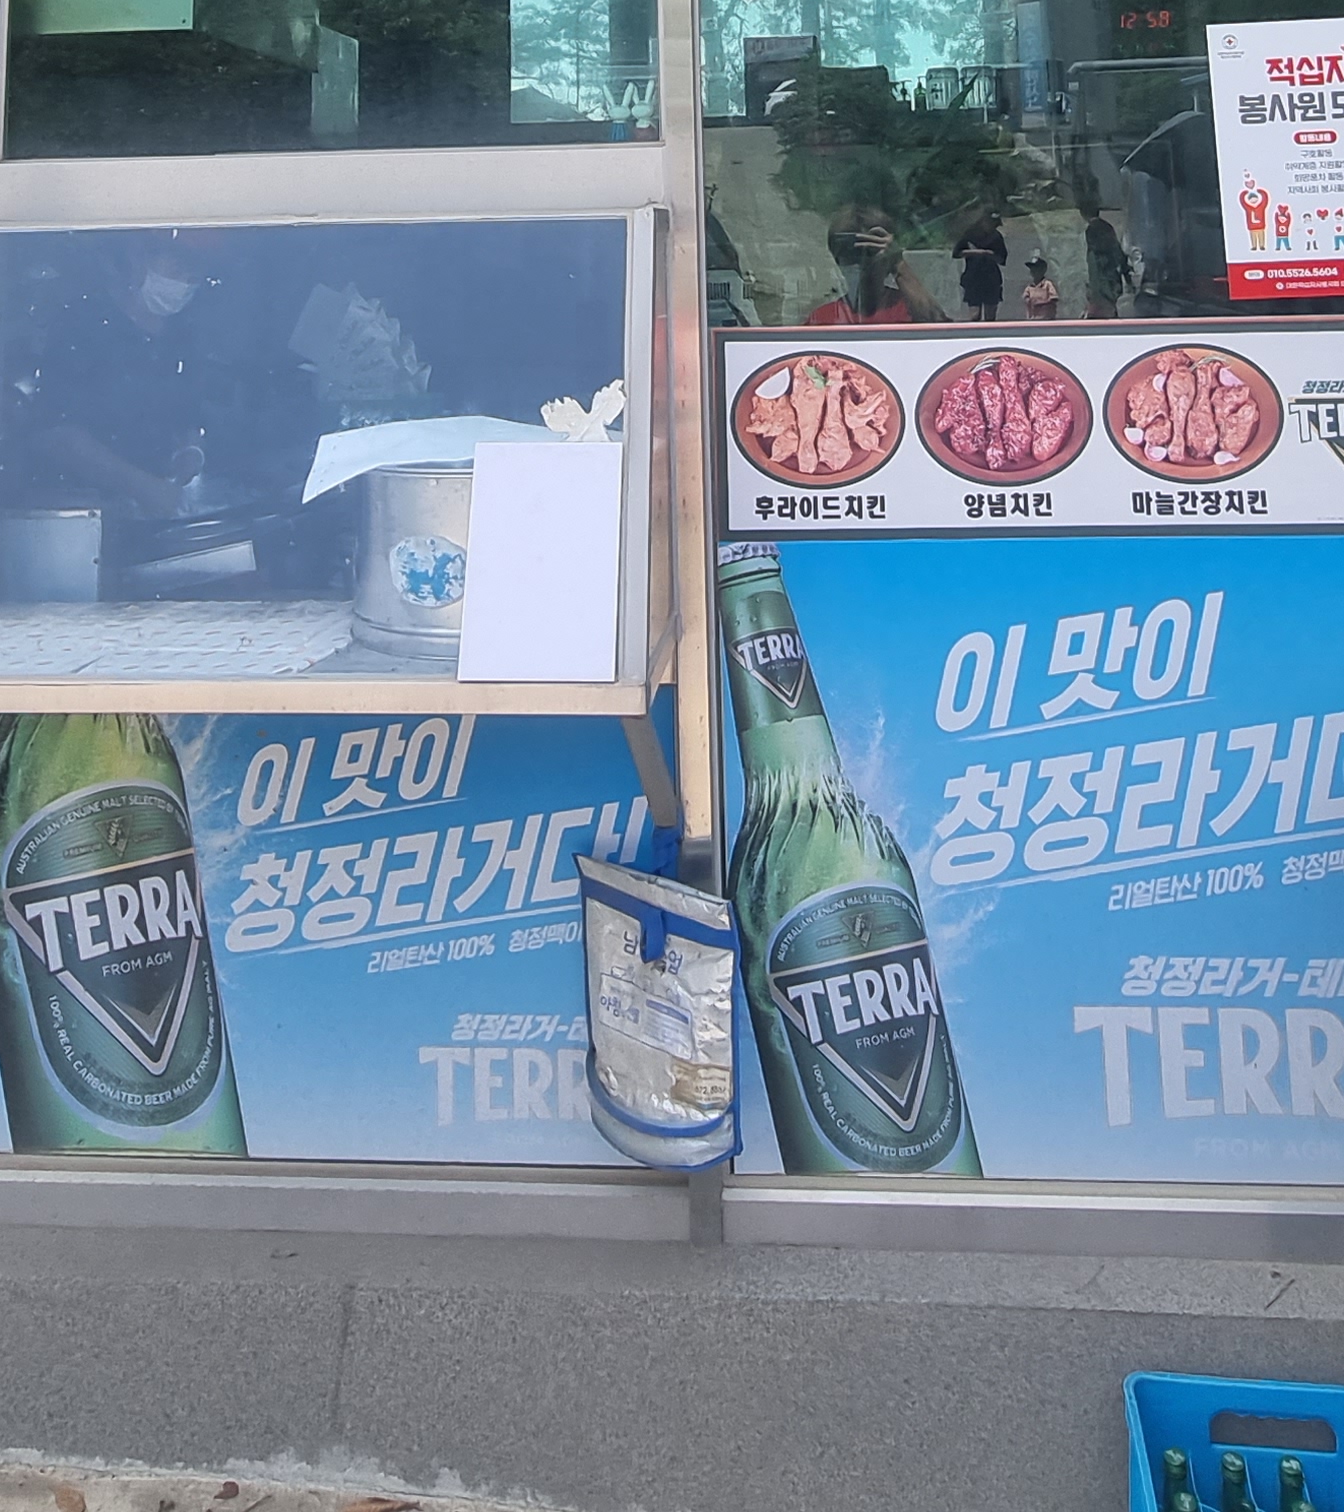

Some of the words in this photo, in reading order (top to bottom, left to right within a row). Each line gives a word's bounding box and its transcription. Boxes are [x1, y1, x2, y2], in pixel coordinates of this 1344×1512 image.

[1238, 91, 1327, 125] 봉사원
[754, 492, 887, 522] 후라이드치킨
[963, 490, 1054, 519] 양념치킨
[1131, 488, 1269, 517] 마늘간장치킨
[934, 624, 1027, 733] 이
[1040, 591, 1224, 721] 맛이
[237, 737, 316, 826] 이
[322, 714, 476, 817] 맛이
[15, 822, 61, 875] AUSTRALIAN
[60, 800, 102, 826] GENUINE
[1108, 872, 1202, 911] 리얼탄산
[1206, 862, 1264, 897] 100%
[25, 869, 203, 973] TERRA
[102, 957, 143, 977] FROM
[146, 951, 174, 968] AGM
[367, 941, 445, 974] 리얼탄산
[447, 933, 497, 962] 100%
[787, 957, 939, 1045] TERRA
[855, 1032, 890, 1049] FROM
[892, 1026, 916, 1040] AGM
[57, 1029, 74, 1062] REAL
[72, 1060, 143, 1106] CARBONATED
[144, 1090, 173, 1106] BEER
[173, 1073, 200, 1099] MADE
[418, 1046, 592, 1128] TERR
[821, 1091, 837, 1121] REAL
[836, 1118, 897, 1157] CARBONATED
